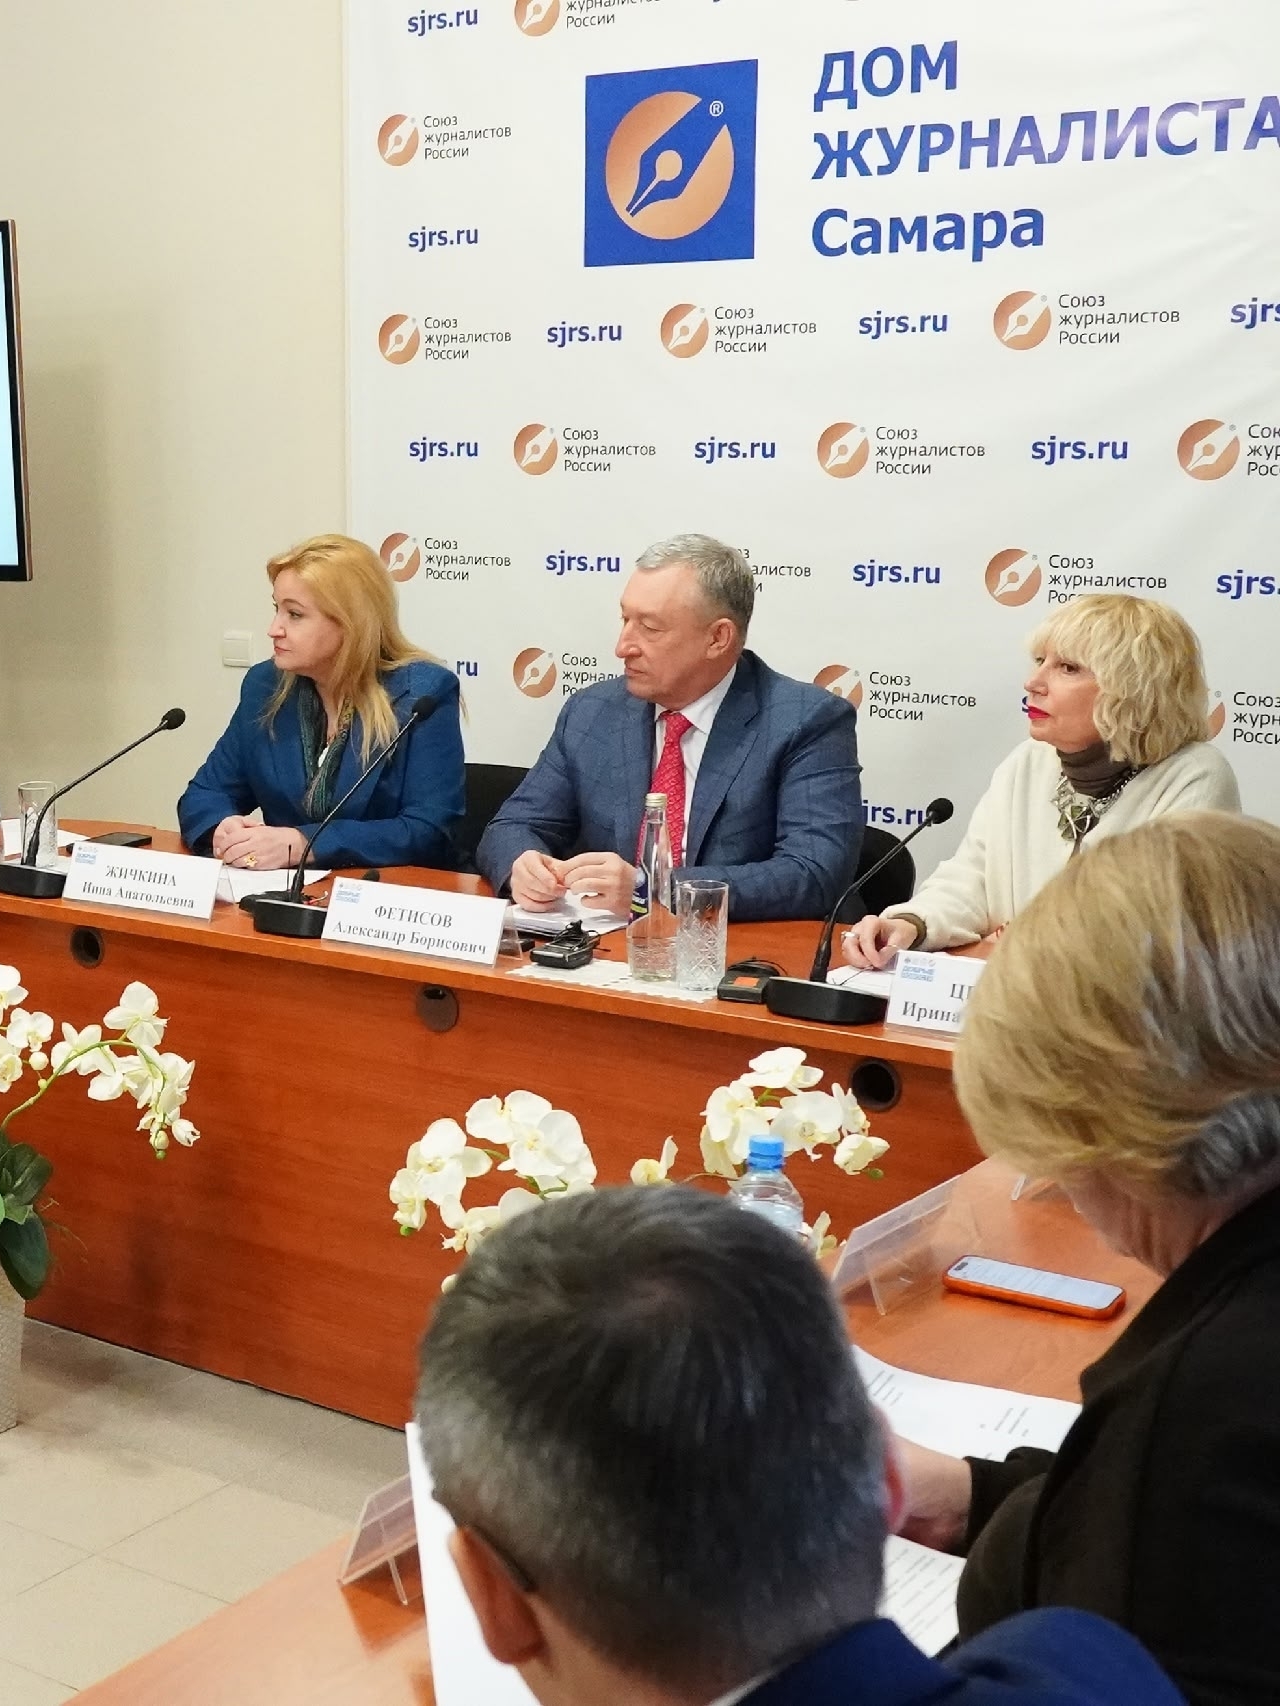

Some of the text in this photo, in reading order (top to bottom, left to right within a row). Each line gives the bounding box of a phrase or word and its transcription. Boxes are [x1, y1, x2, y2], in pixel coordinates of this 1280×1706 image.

[566, 0, 662, 13] журнал
[407, 8, 479, 36] sjrs.ru
[566, 14, 615, 29] России
[813, 40, 958, 113] ДОМ
[423, 116, 458, 128] Союз
[424, 127, 512, 144] журналистов
[811, 96, 1280, 180] ЖУРНАЛИСТА
[424, 145, 469, 160] России
[408, 226, 479, 252] sjrs.ru
[812, 208, 1044, 262] Самара
[1058, 294, 1105, 309] Союз
[715, 306, 755, 320] Союз
[1058, 309, 1181, 329] журналистов
[424, 317, 458, 329] Союз
[715, 322, 817, 338] журналистов
[859, 311, 948, 339] sjrs.ru
[425, 331, 512, 346] журналистов
[547, 321, 622, 344] sjrs.ru
[1058, 331, 1120, 345] России
[425, 348, 470, 360] России
[715, 340, 767, 353] России
[563, 428, 599, 440] Союз
[876, 426, 918, 440] Союз
[409, 438, 479, 462] sjrs.ru
[564, 443, 656, 457] журналистов
[695, 437, 776, 464] sjrs.ru
[876, 444, 985, 459] журналистов
[1031, 436, 1128, 466] sjrs.ru
[564, 459, 611, 472] России
[876, 461, 931, 475] России
[1247, 462, 1280, 476] Рос
[425, 538, 458, 549] Союз
[425, 553, 511, 568] журналистов
[546, 550, 620, 575] sjrs.ru
[1049, 554, 1094, 569] Союз
[426, 569, 469, 581] России
[752, 564, 811, 577] алистов
[852, 559, 941, 587] sjrs.ru
[1048, 574, 1167, 590] журналистов
[1216, 569, 1280, 600] sjrs.
[1048, 590, 1085, 604] Рос
[562, 653, 597, 667] Союз
[562, 671, 618, 684] журнал
[869, 671, 911, 686] Союз
[869, 690, 977, 707] журналистов
[1233, 691, 1280, 708] Союз
[869, 707, 924, 721] России
[1233, 728, 1280, 745] Росс
[862, 799, 931, 827] jrs.r
[105, 865, 177, 887] ЖИЧКИНА
[114, 887, 195, 909] Анатольевна
[374, 905, 453, 928] ФЕТИСОВ
[332, 920, 487, 955] Александр Борисович
[902, 1001, 961, 1022] Ирина
